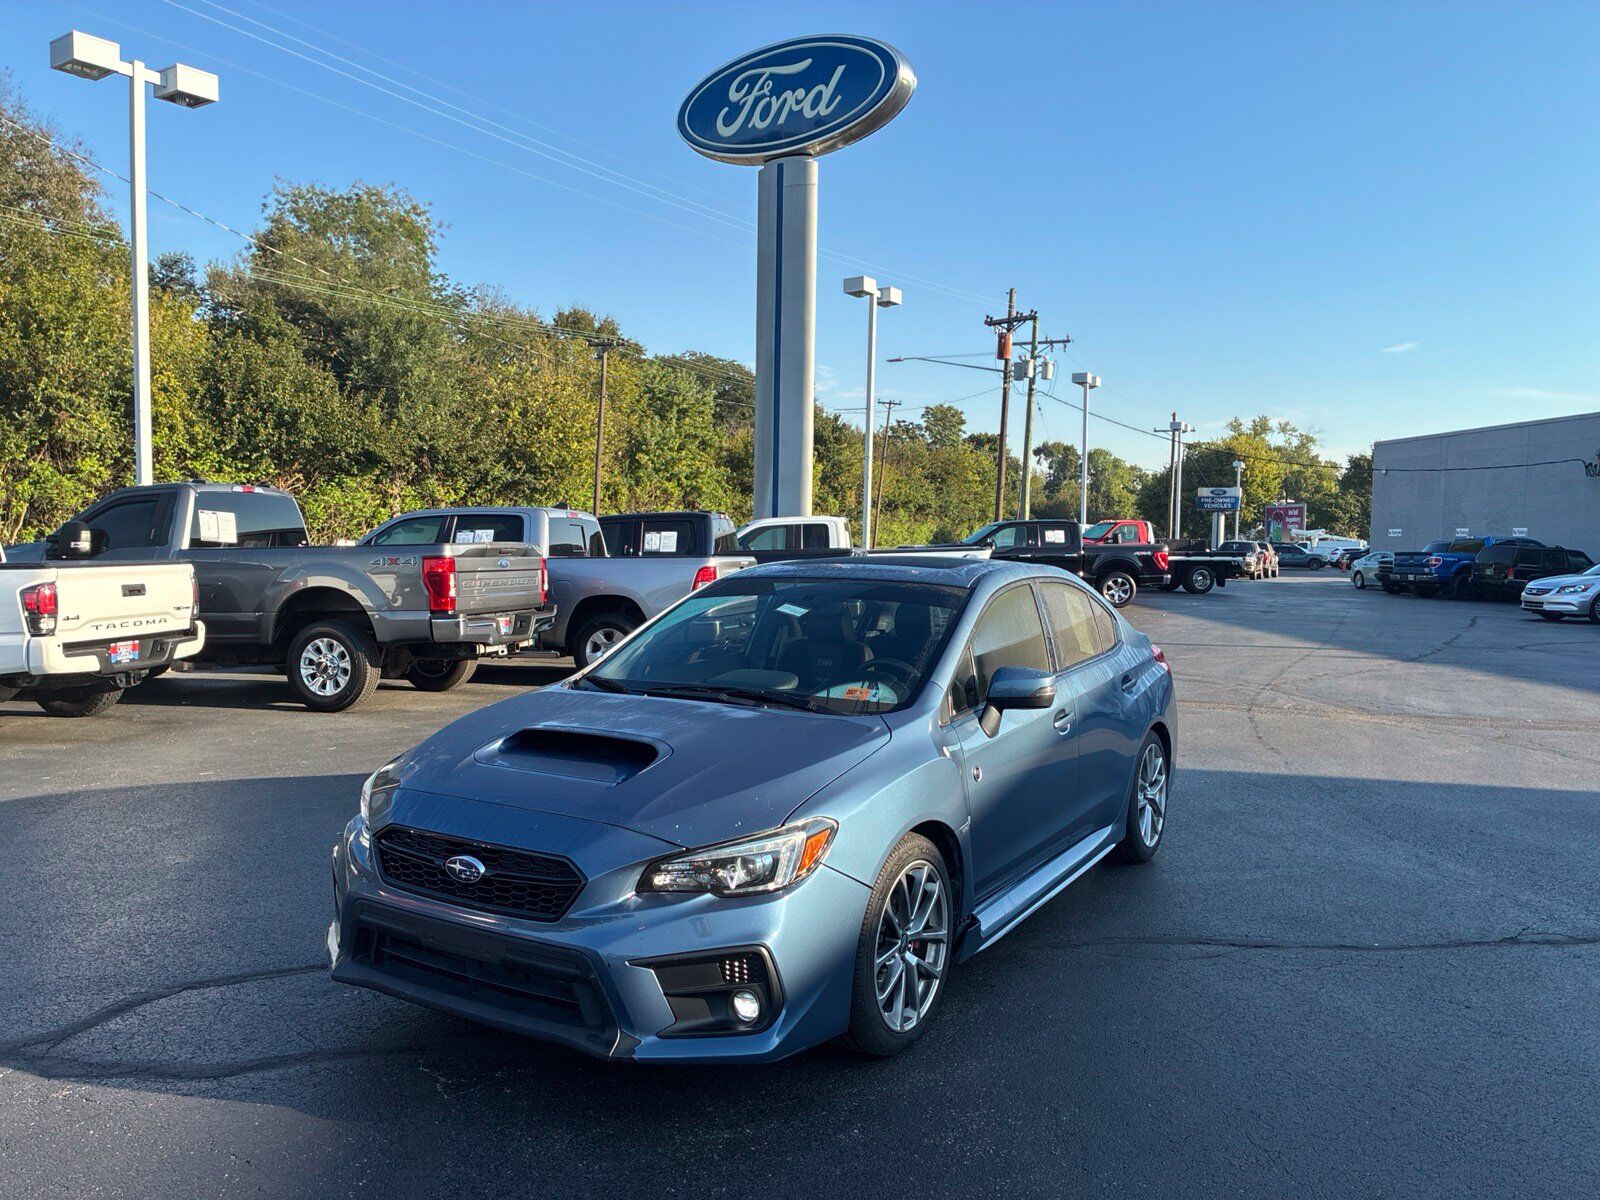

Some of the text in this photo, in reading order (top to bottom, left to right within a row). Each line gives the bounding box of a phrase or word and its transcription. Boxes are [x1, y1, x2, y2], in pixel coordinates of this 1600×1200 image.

[716, 58, 847, 137] Ford
[369, 556, 417, 567] 4X4
[90, 617, 167, 631] TACOMA
